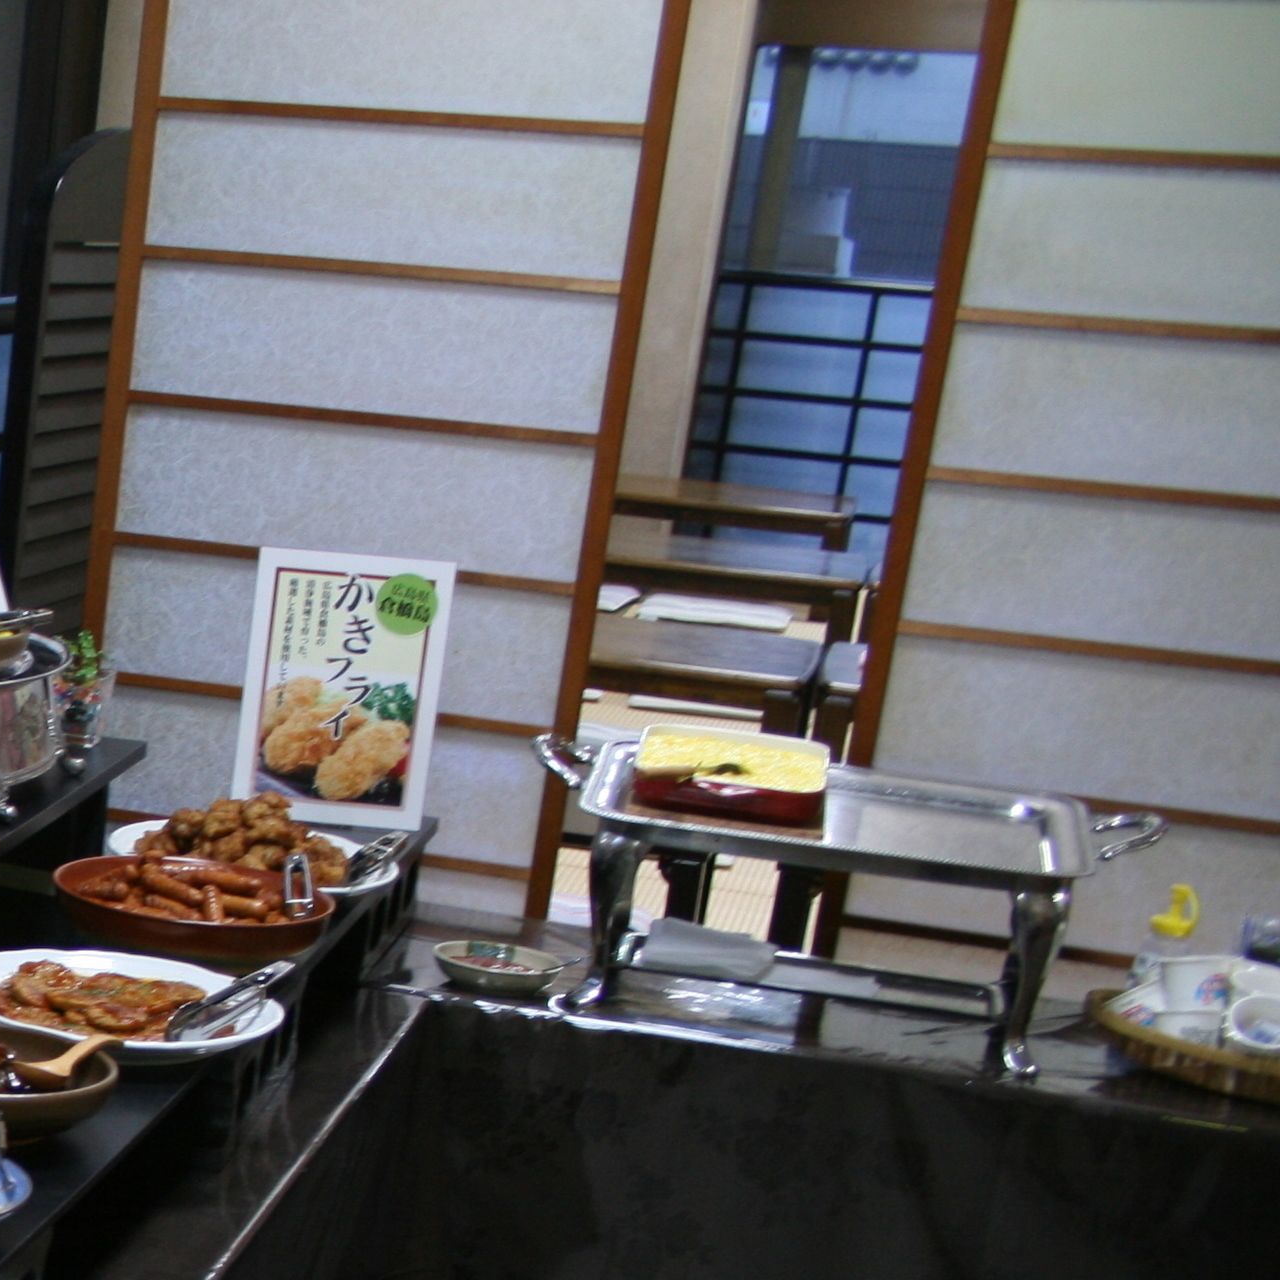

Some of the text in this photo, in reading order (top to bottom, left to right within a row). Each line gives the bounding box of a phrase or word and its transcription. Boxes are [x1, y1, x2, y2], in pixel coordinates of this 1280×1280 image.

[320, 573, 375, 739] かきフライ
